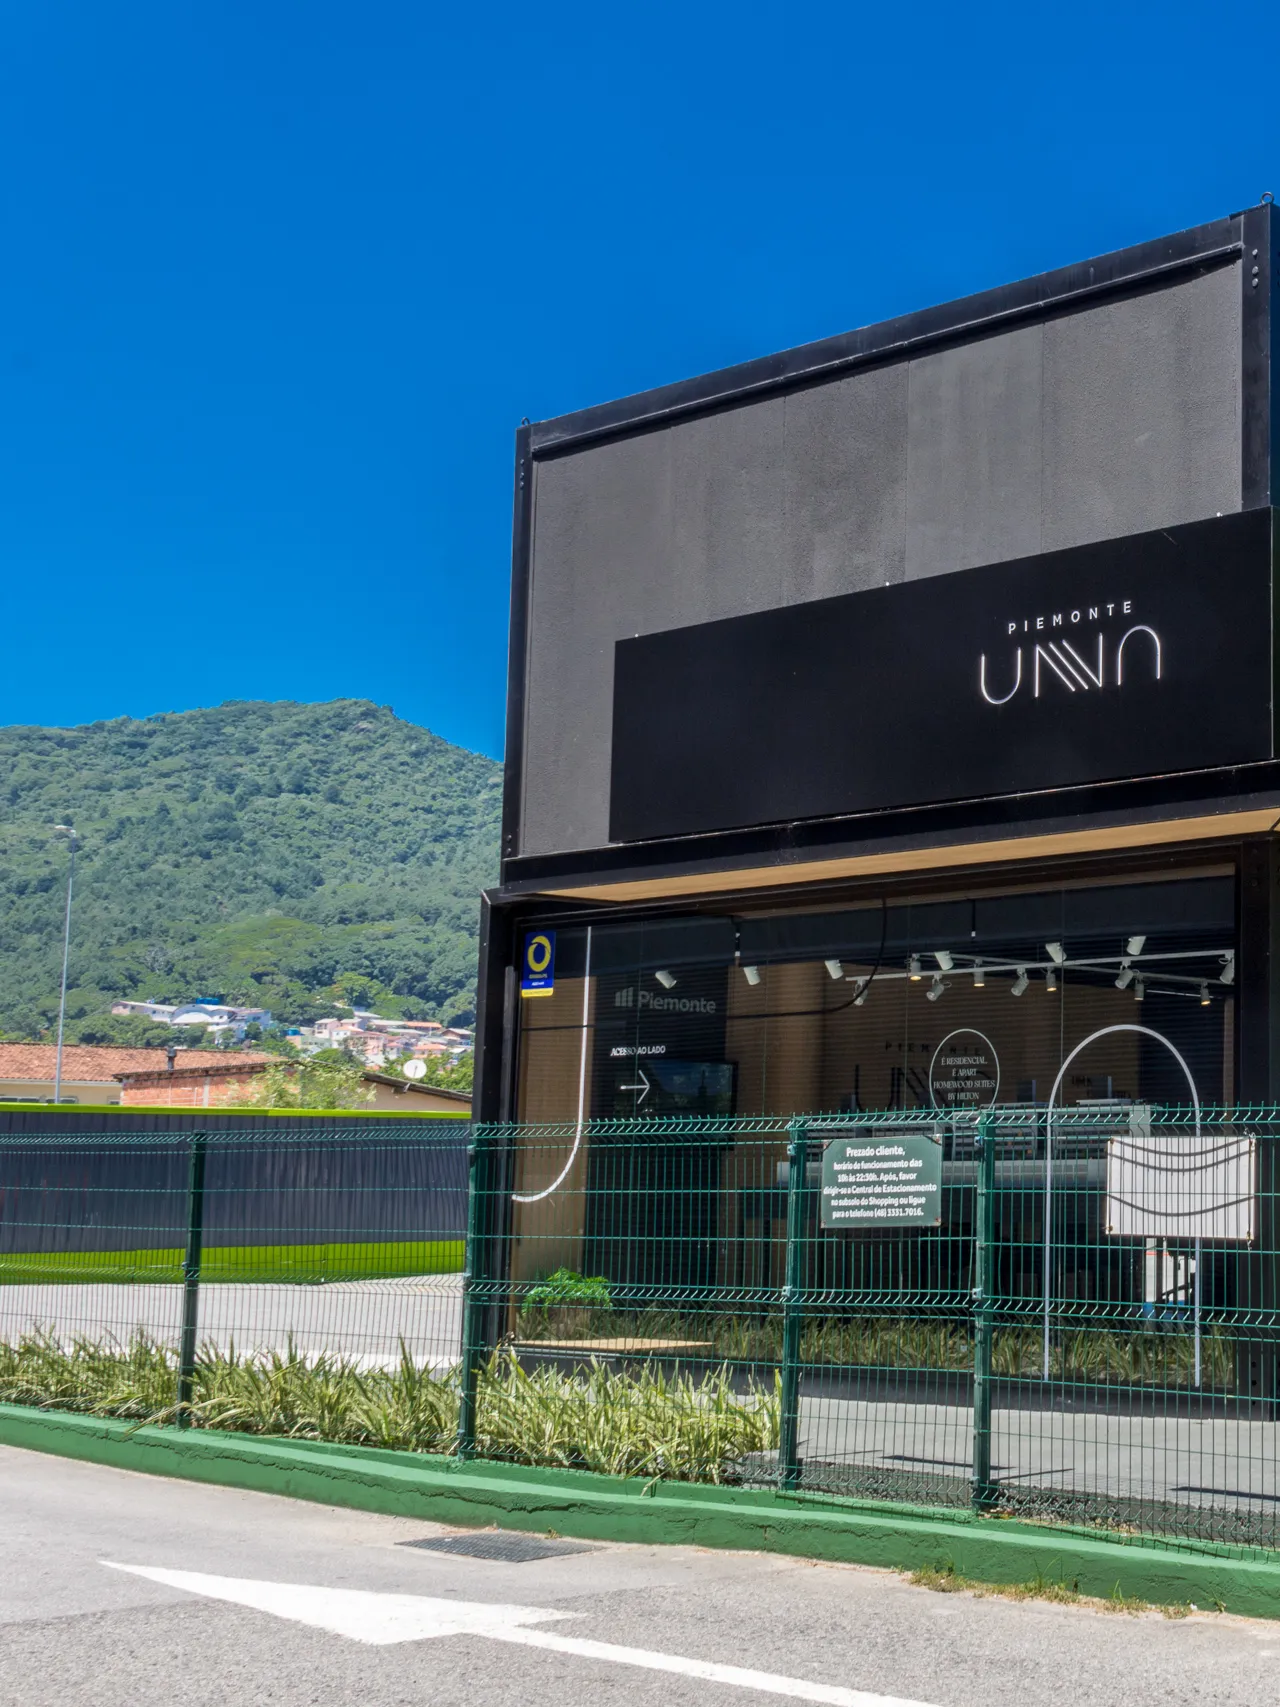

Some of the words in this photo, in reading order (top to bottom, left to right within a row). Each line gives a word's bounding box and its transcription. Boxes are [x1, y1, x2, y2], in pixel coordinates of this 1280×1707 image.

[1007, 600, 1133, 635] PIEMONTE
[638, 990, 716, 1014] Piemonte
[610, 1046, 636, 1057] ACESSO
[637, 1046, 647, 1055] AO
[647, 1045, 666, 1054] LADO
[958, 1068, 977, 1077] APART
[933, 1080, 973, 1089] HOMEWOOD
[974, 1079, 996, 1088] SUITES
[947, 1092, 956, 1101] BY
[957, 1091, 980, 1100] HILTON
[846, 1146, 875, 1157] Prezado
[876, 1145, 905, 1156] cliente,
[833, 1161, 853, 1170] horário
[853, 1161, 860, 1170] de
[861, 1160, 909, 1170] funcionamento
[909, 1158, 923, 1167] das
[880, 1172, 898, 1183] Após,
[899, 1171, 917, 1180] favor
[851, 1185, 873, 1194] Central
[874, 1184, 882, 1193] de
[882, 1183, 937, 1193] Estacionamento
[839, 1197, 860, 1206] subsolo
[860, 1197, 868, 1206] do
[868, 1195, 898, 1206] Shopping
[899, 1197, 908, 1205] ou
[908, 1195, 926, 1206] ligue
[832, 1210, 844, 1220] para
[850, 1208, 874, 1218] telefone
[874, 1207, 887, 1218] (48)
